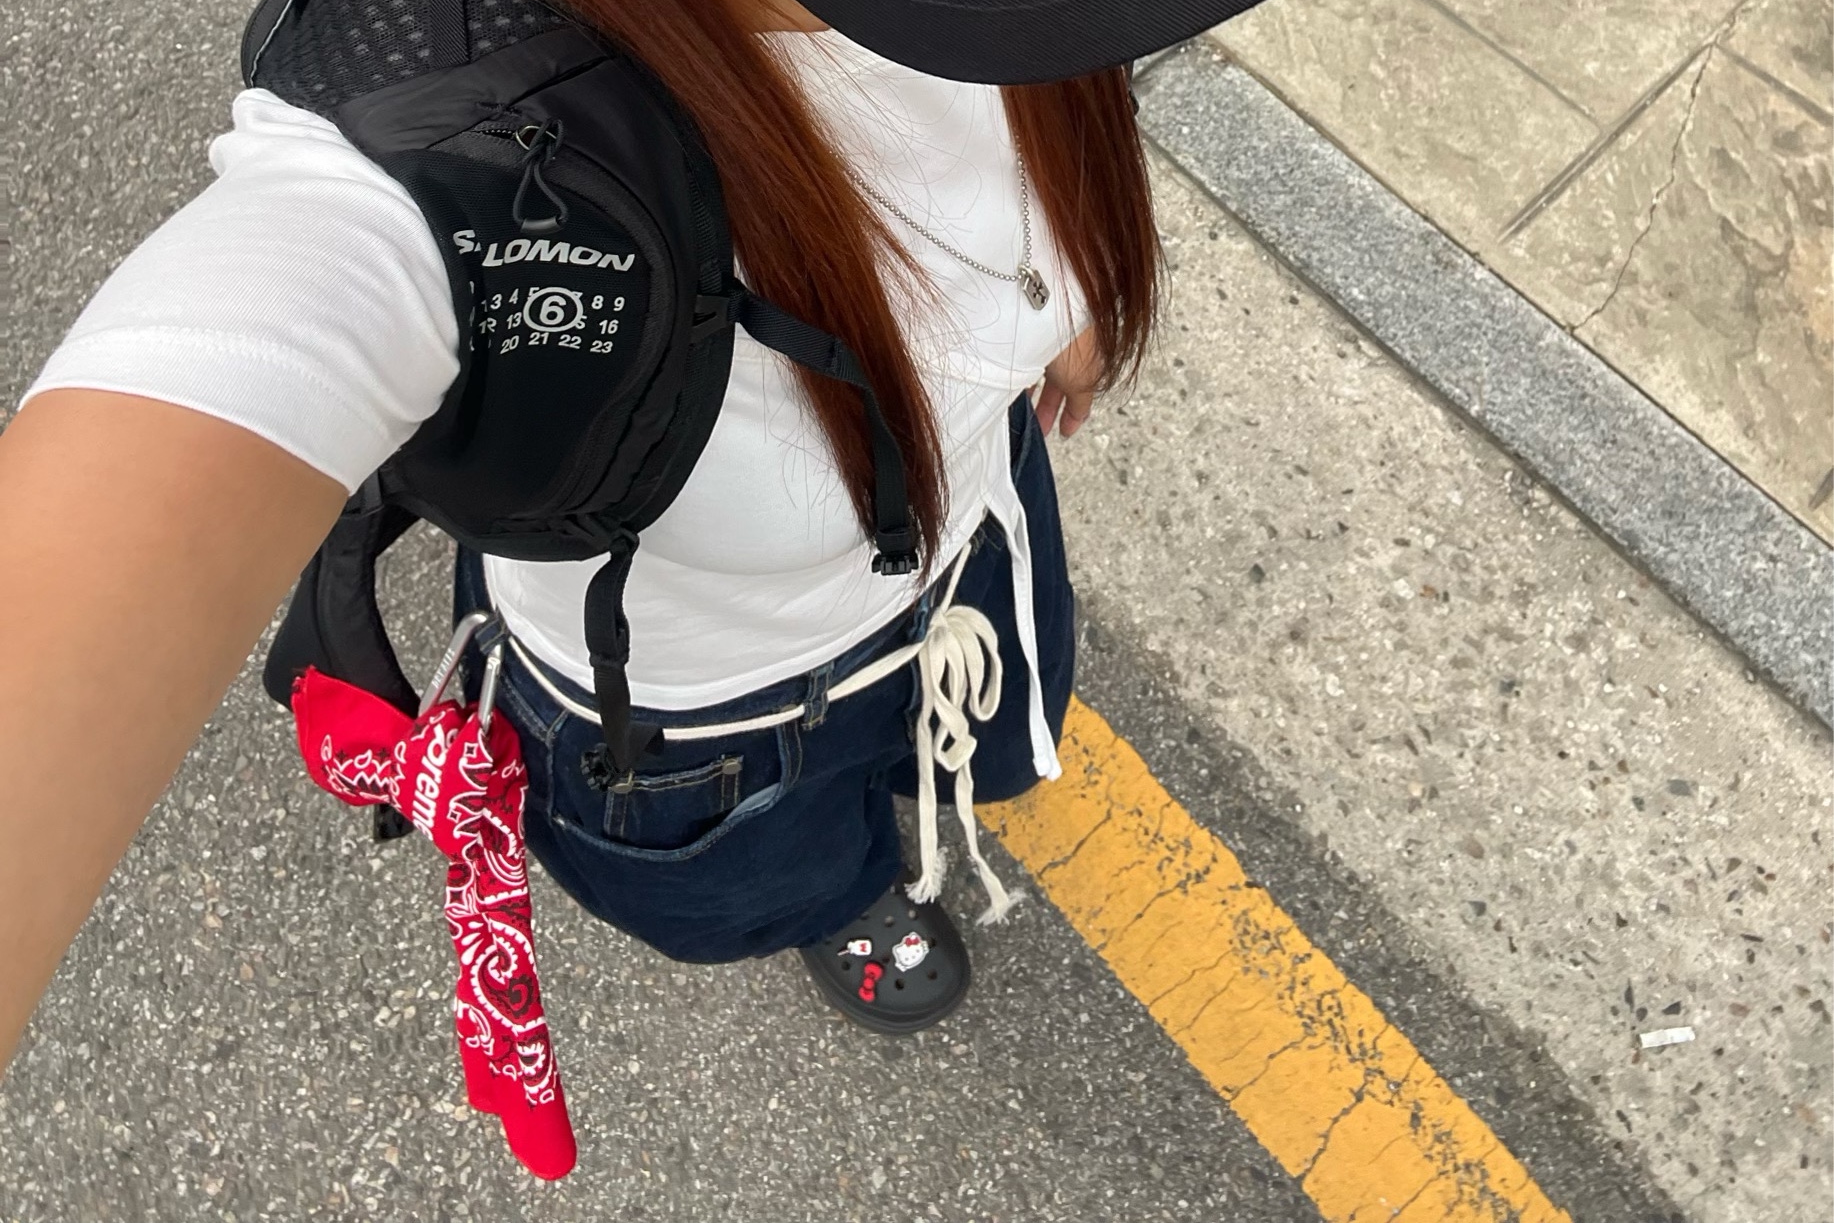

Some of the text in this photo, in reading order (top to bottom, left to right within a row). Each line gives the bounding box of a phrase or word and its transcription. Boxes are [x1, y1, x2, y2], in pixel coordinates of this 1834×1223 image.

[453, 229, 635, 272] SLOMON
[490, 293, 503, 310] 3
[508, 288, 519, 305] 4
[539, 294, 567, 326] 6
[591, 294, 604, 310] 8
[613, 296, 625, 312] 9
[506, 311, 523, 330] 13
[599, 319, 620, 335] 16
[500, 335, 520, 355] 20
[528, 331, 550, 346] 21
[558, 333, 582, 350] 22
[590, 339, 614, 354] 23
